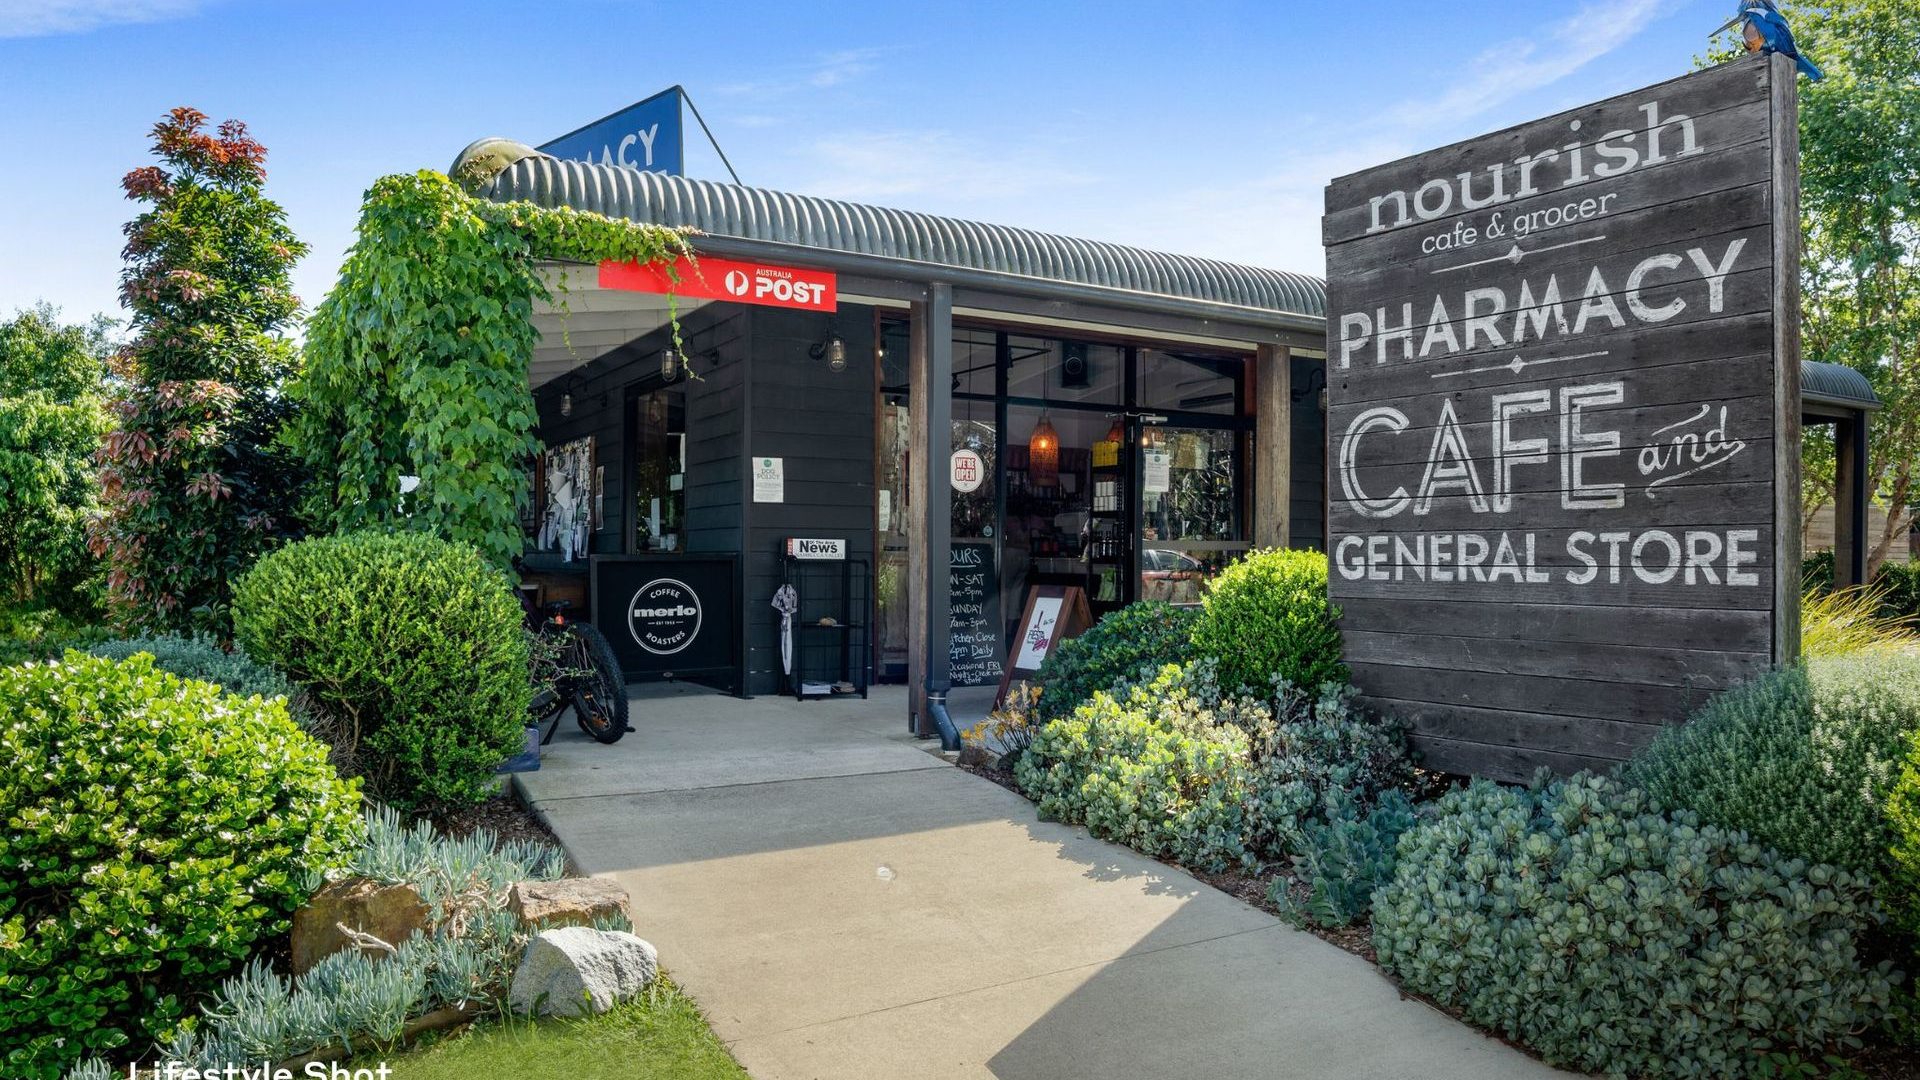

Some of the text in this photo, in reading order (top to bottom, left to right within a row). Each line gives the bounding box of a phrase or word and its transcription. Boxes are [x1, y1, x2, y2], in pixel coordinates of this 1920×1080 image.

[574, 123, 658, 169] ACY
[1366, 101, 1704, 234] nourish
[1421, 193, 1617, 254] cafe & grocer
[755, 268, 793, 279] AUSTRALIA
[755, 276, 825, 304] POST
[1340, 238, 1748, 369] PHARMACY
[1339, 381, 1744, 518] CAFE and
[955, 468, 976, 481] OPEN
[800, 540, 838, 554] News
[1335, 530, 1760, 586] GENERAL STORE
[650, 588, 681, 599] COFFEE
[633, 605, 697, 617] merlo
[645, 630, 686, 645] ROASTERS
[971, 644, 994, 659] Daily
